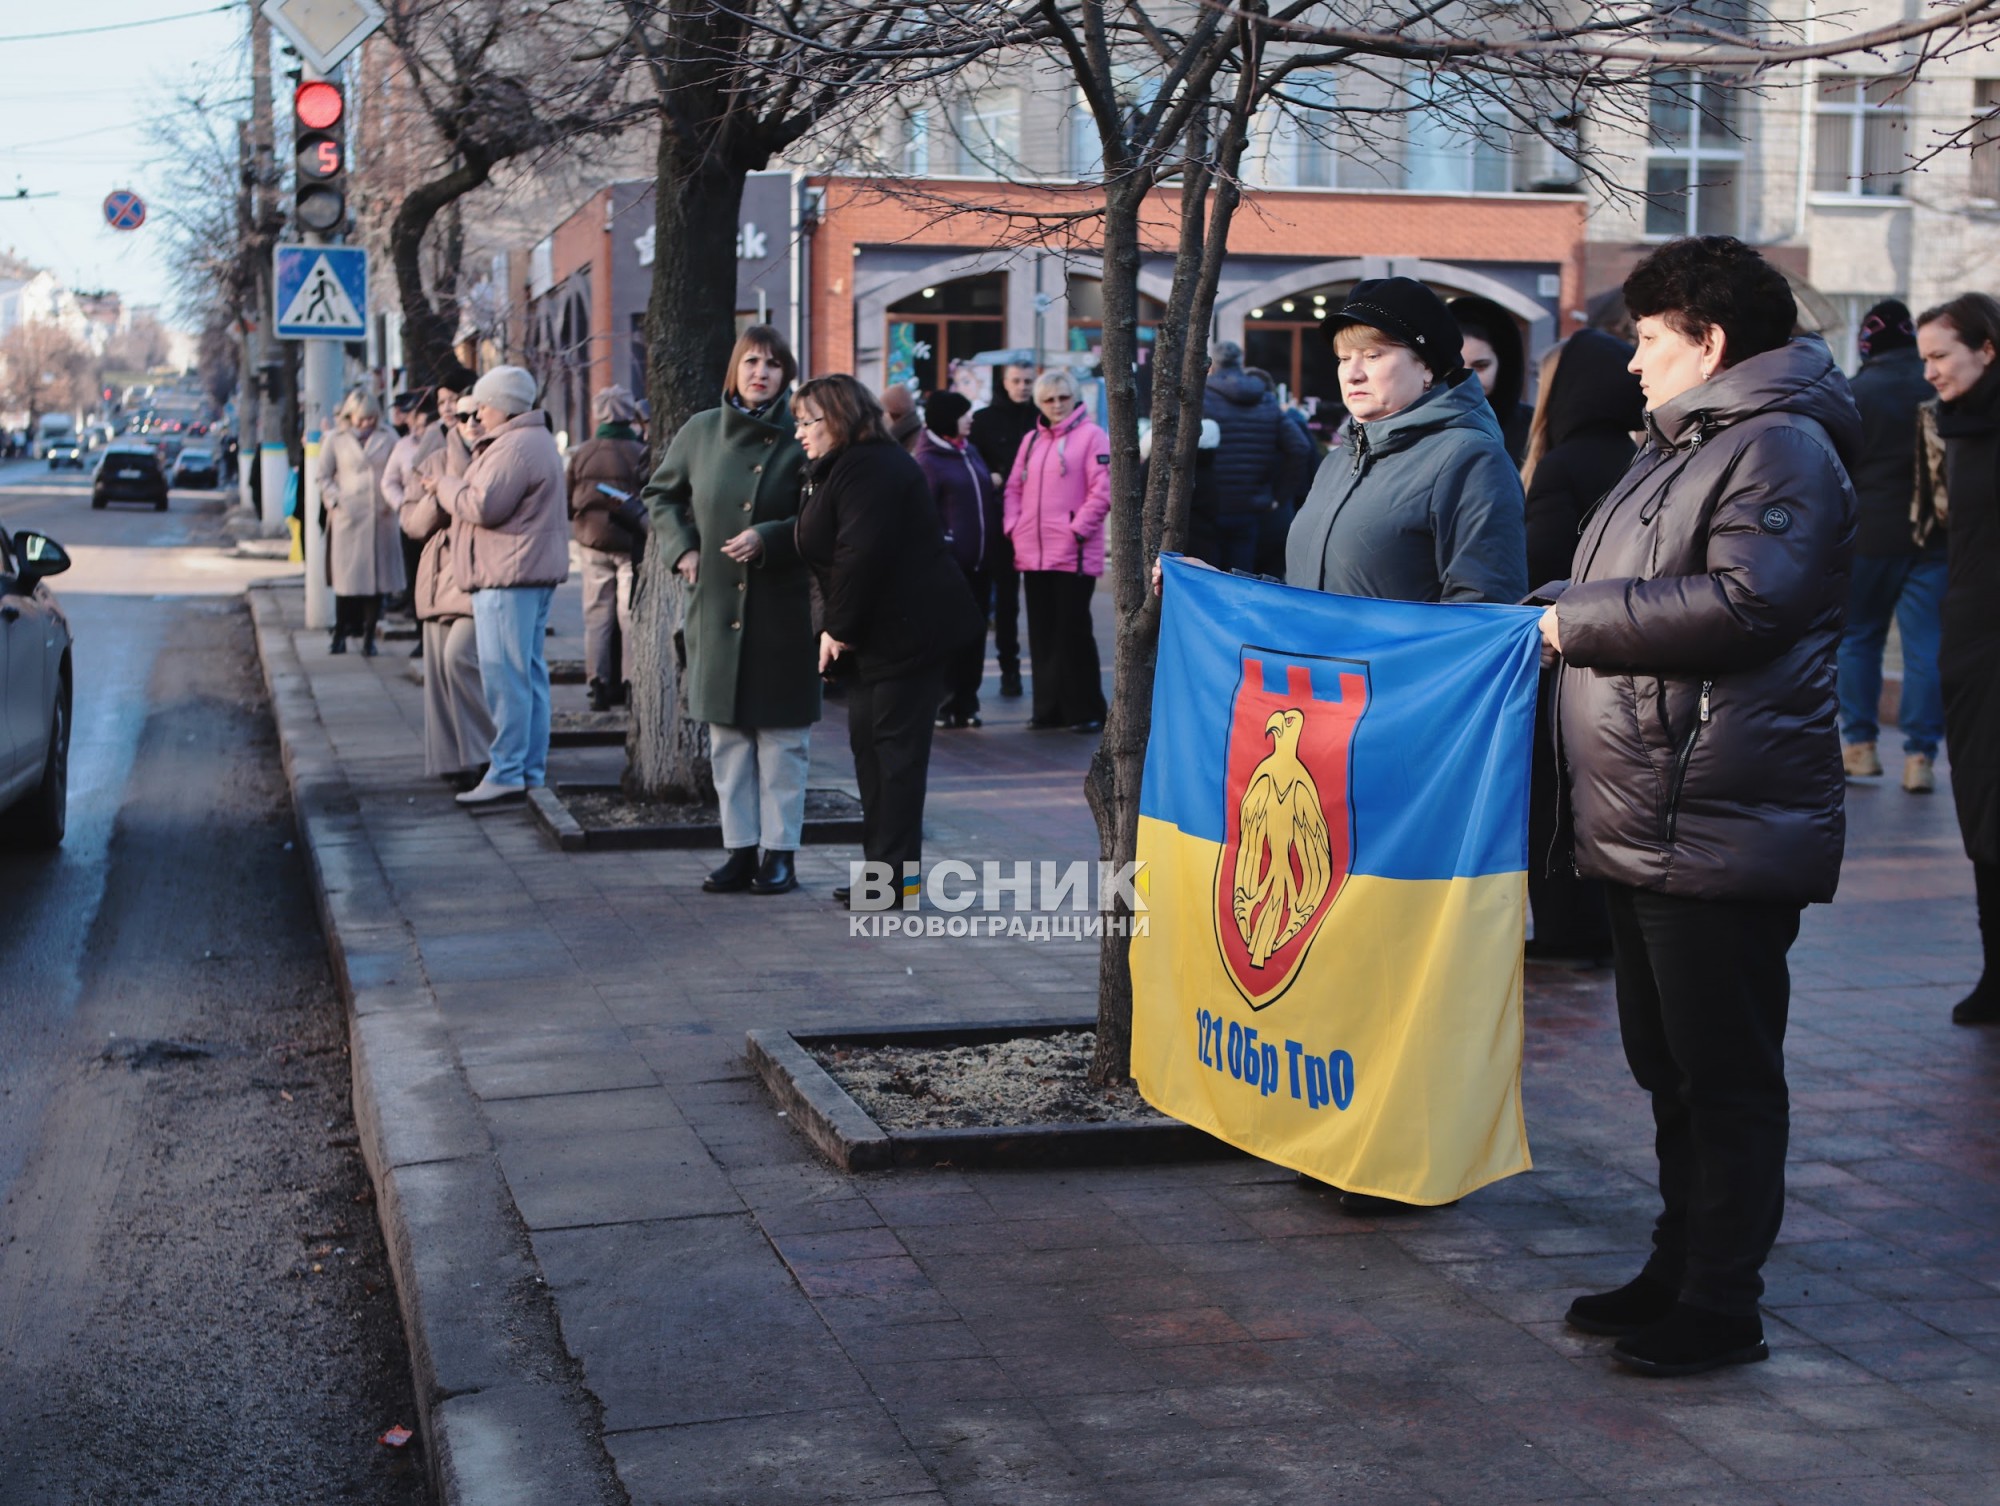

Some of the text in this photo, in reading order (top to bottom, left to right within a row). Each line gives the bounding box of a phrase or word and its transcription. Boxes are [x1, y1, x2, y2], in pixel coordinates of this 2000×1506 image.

[318, 141, 338, 173] 5
[1196, 1007, 1223, 1072] 121
[1285, 1039, 1354, 1111] ТрО
